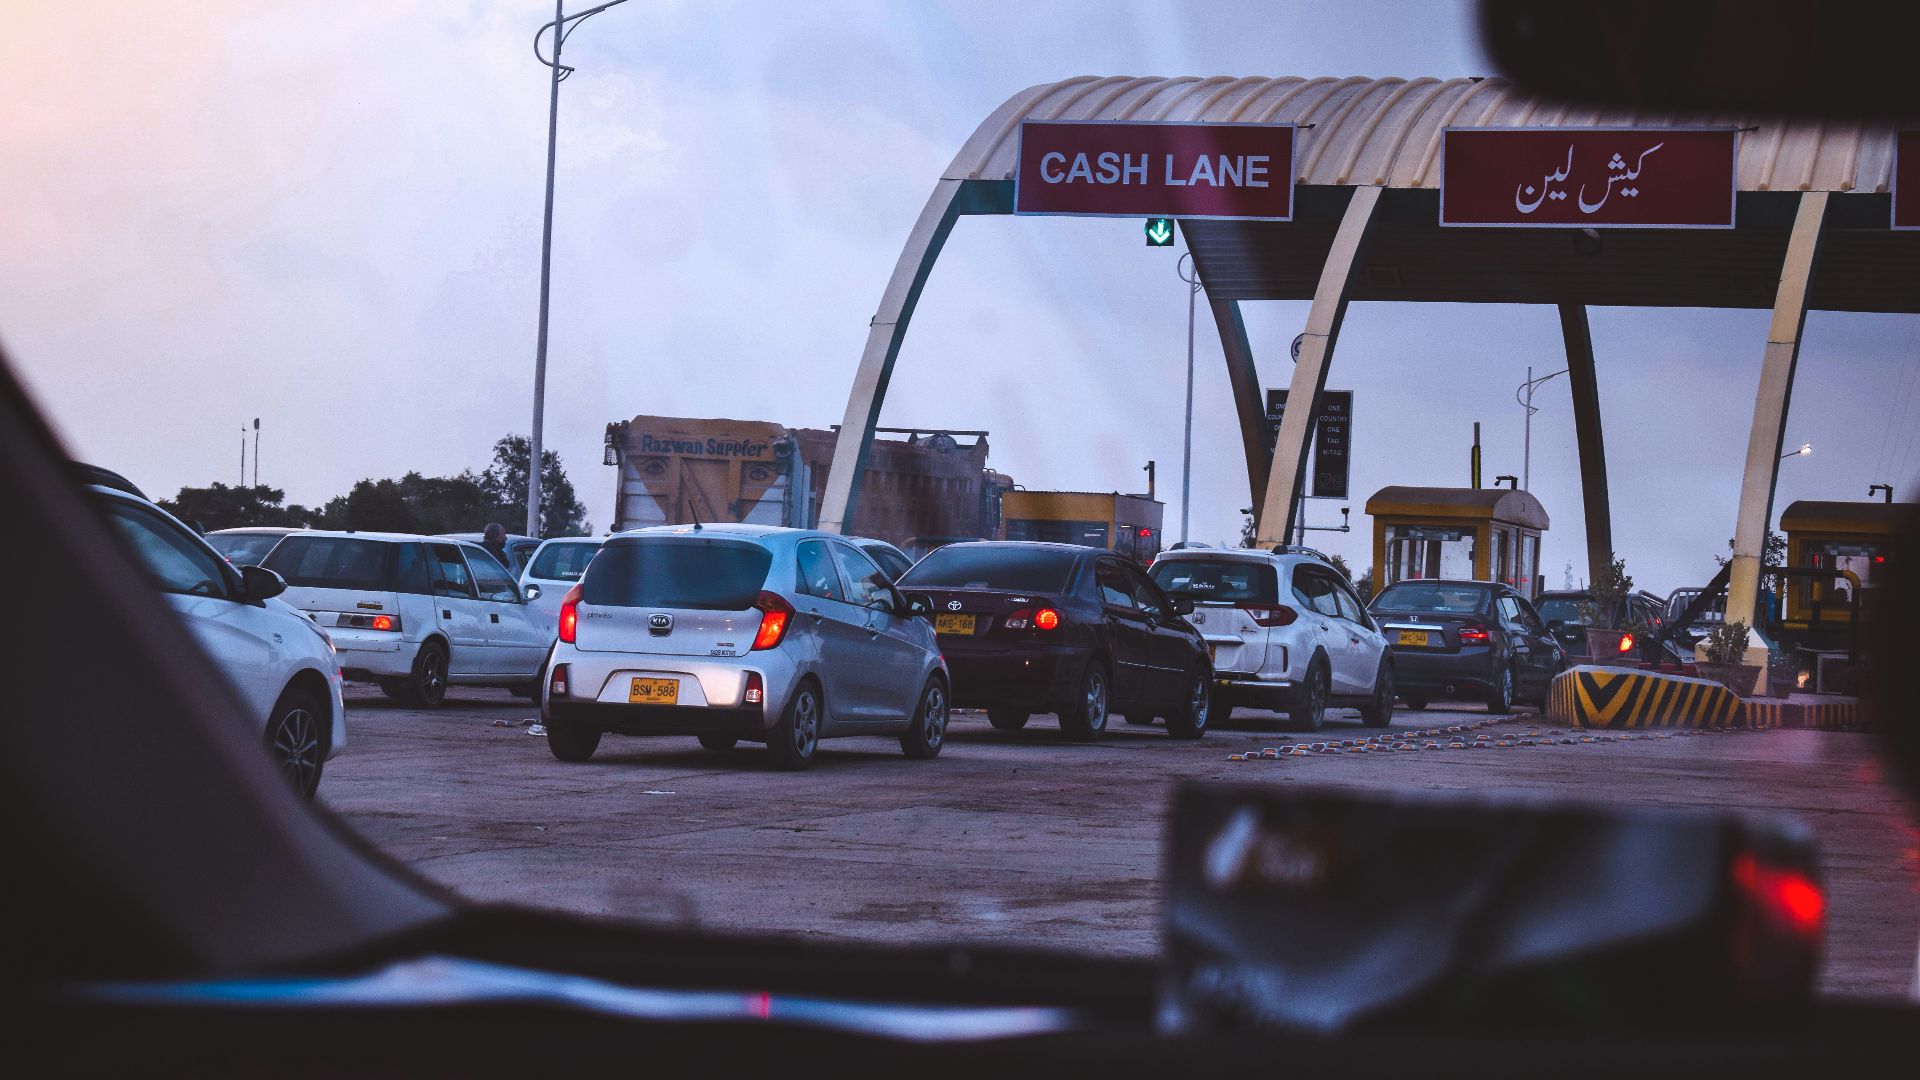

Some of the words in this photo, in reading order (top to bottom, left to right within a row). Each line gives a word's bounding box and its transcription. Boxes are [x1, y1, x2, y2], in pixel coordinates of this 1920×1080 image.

[1040, 151, 1149, 185] CASH
[1165, 154, 1270, 188] LANE
[1515, 143, 1574, 213] لین
[1578, 142, 1664, 213] کیش
[642, 434, 704, 455] Razwan
[937, 618, 974, 630] AKG-168
[632, 684, 676, 698] BSM-588
